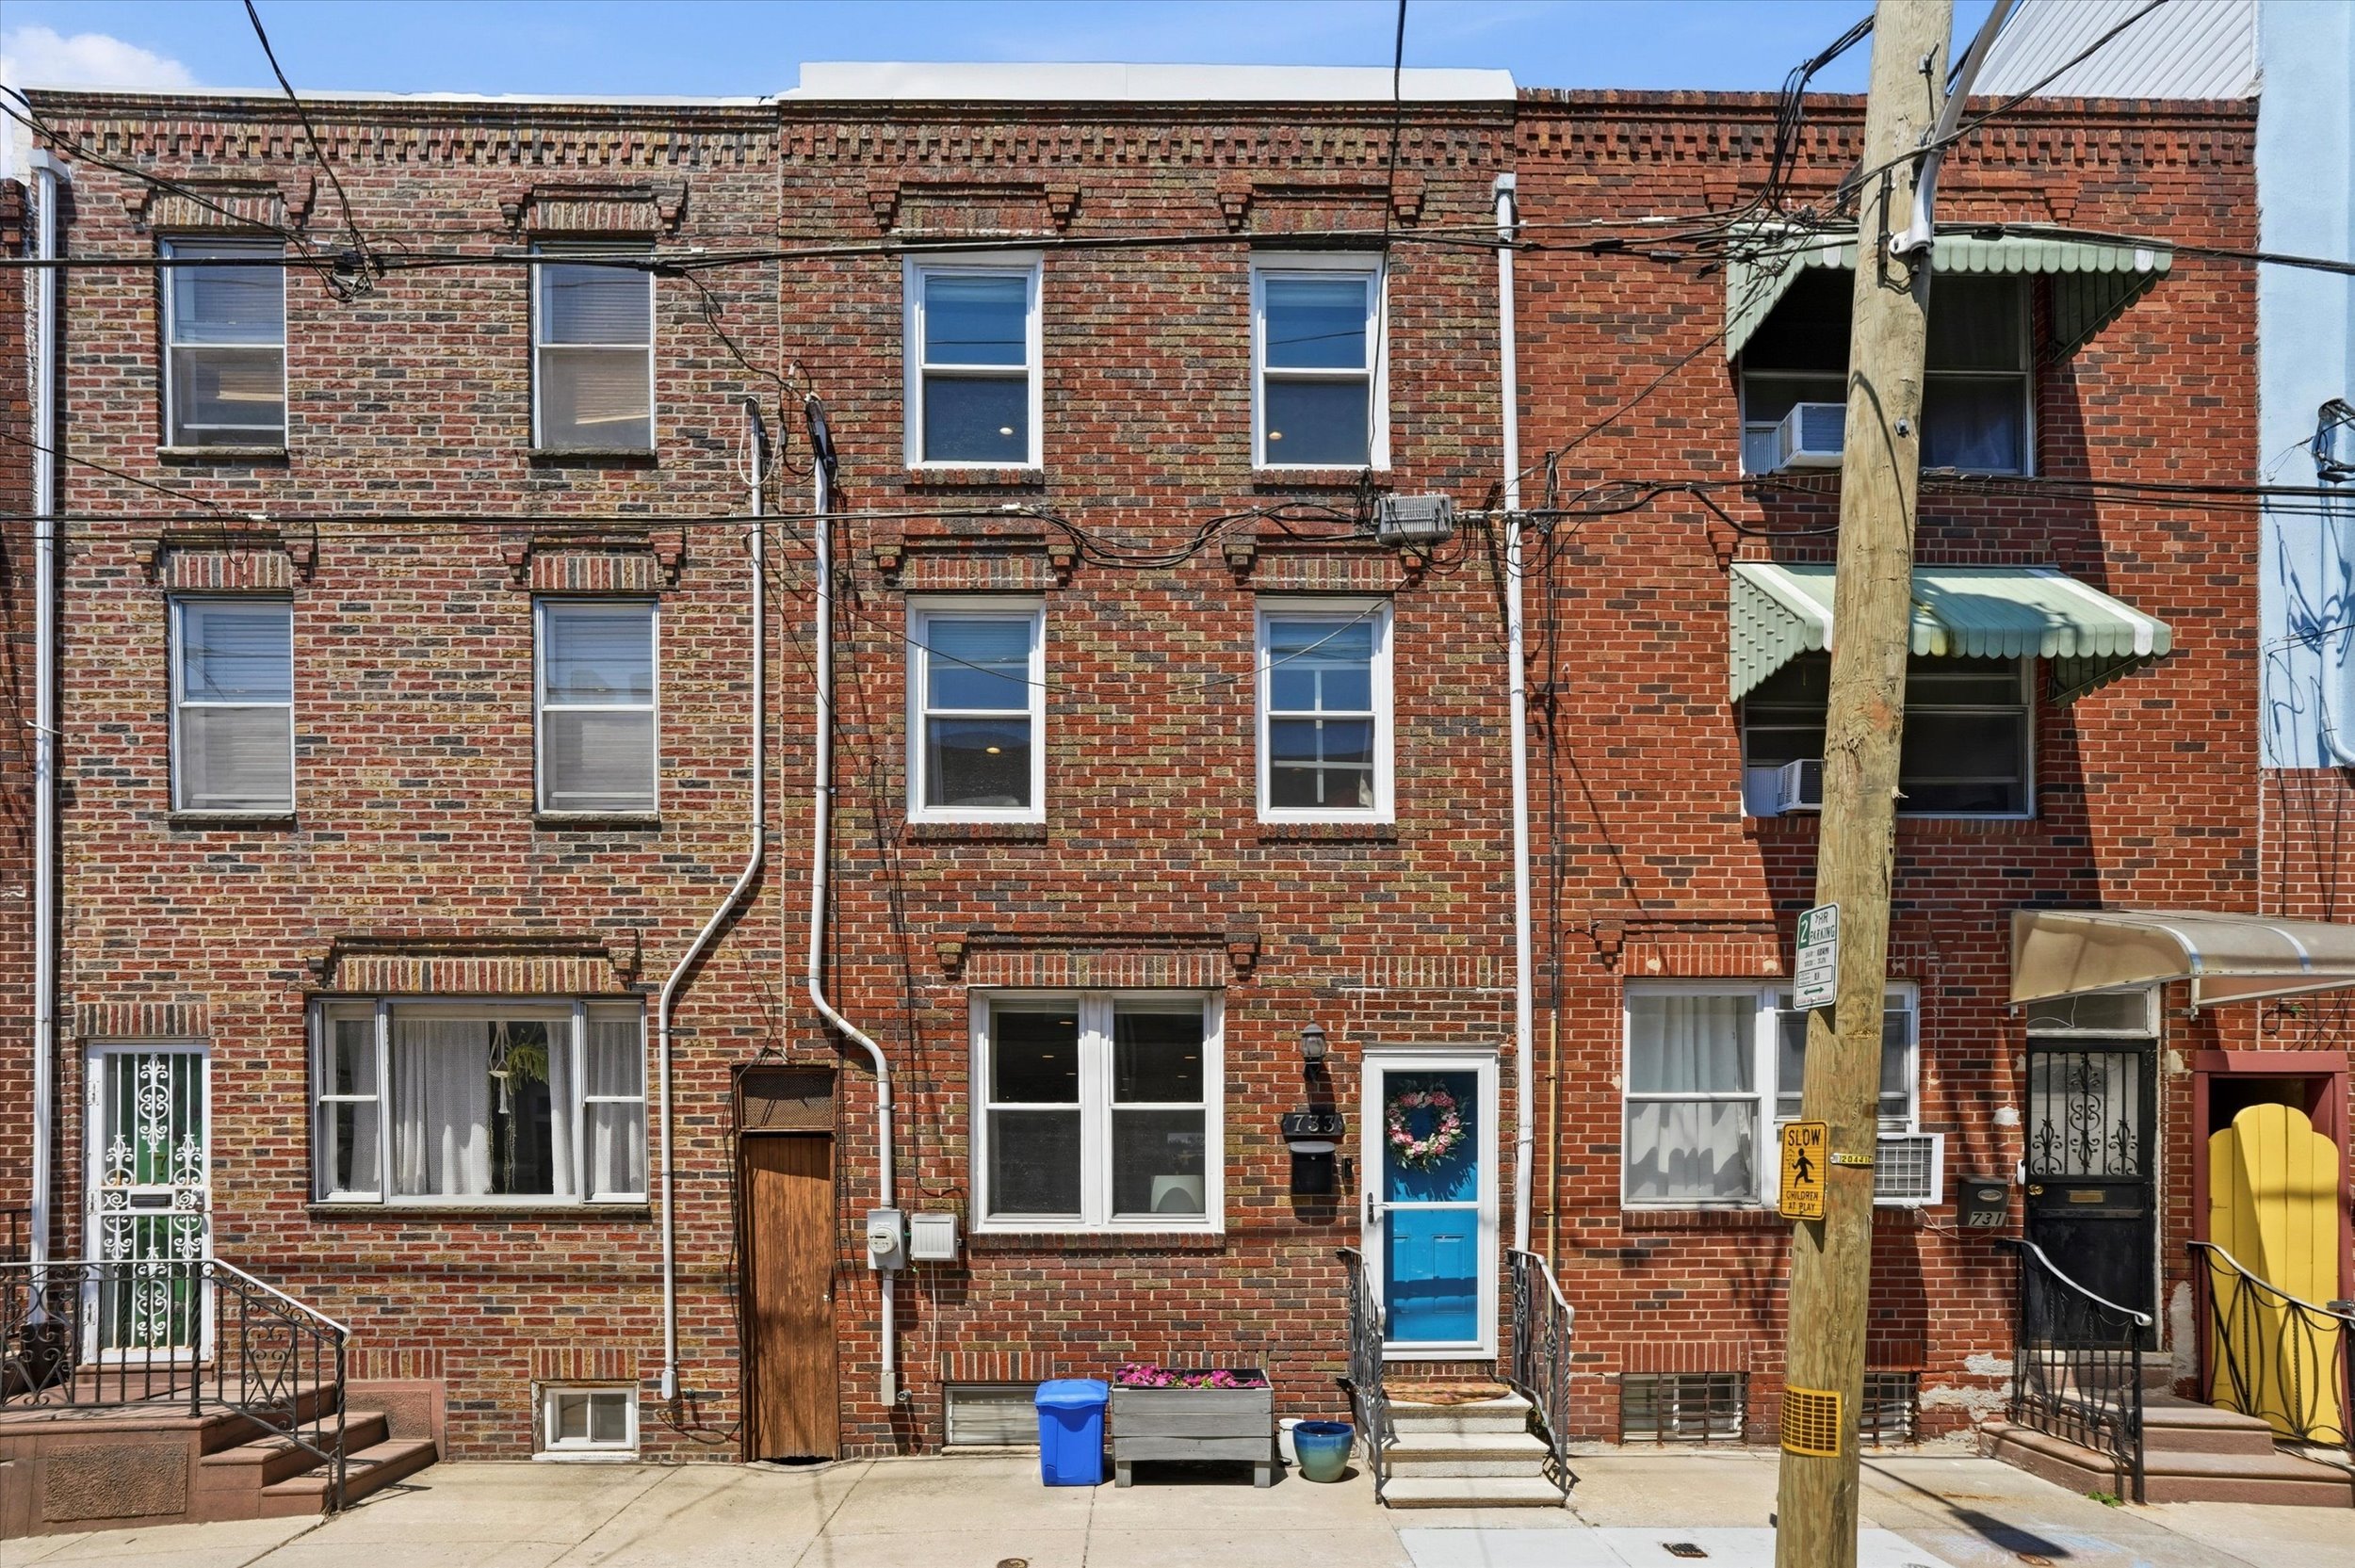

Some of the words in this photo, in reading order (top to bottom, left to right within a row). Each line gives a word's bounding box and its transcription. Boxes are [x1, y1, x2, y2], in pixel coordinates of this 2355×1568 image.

[1800, 919, 1809, 944] 2
[1810, 925, 1835, 943] PARKING
[1293, 1114, 1335, 1132] 733
[1788, 1128, 1821, 1146] SLOW
[1786, 1190, 1818, 1201] CHILDREN
[1788, 1201, 1795, 1210] AT
[1799, 1202, 1815, 1212] PLAY
[1972, 1213, 2002, 1225] 731
